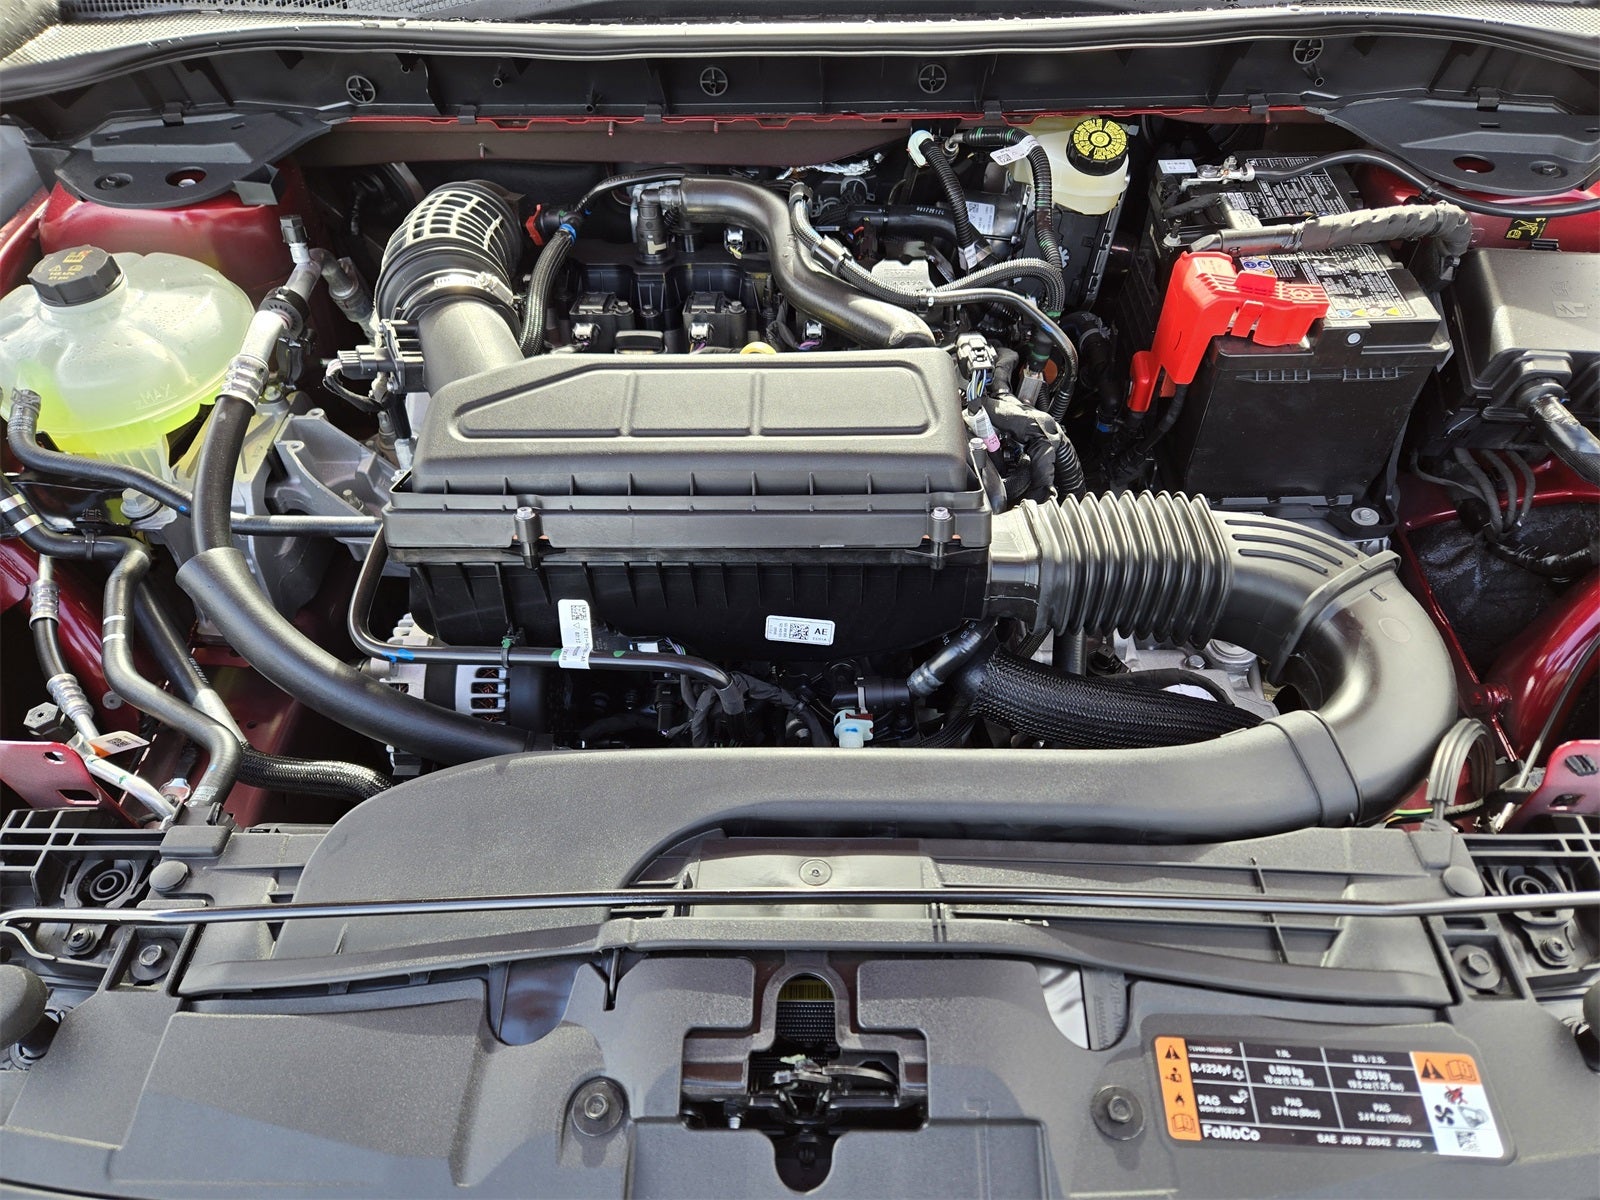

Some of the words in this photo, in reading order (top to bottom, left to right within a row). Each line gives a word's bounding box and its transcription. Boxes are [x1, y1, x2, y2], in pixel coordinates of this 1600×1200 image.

[814, 627, 828, 636] AE
[1190, 1062, 1231, 1076] R-1234yf
[1291, 1066, 1304, 1079] kg
[1378, 1071, 1391, 1083] kg
[1197, 1094, 1221, 1106] PAG
[1284, 1096, 1303, 1108] PAG
[1372, 1102, 1392, 1113] PAG
[1202, 1124, 1261, 1141] FoMoCo
[1317, 1133, 1338, 1144] SAE
[1341, 1134, 1363, 1146] J639
[1365, 1136, 1392, 1147] J2842
[1396, 1138, 1422, 1149] J2845
